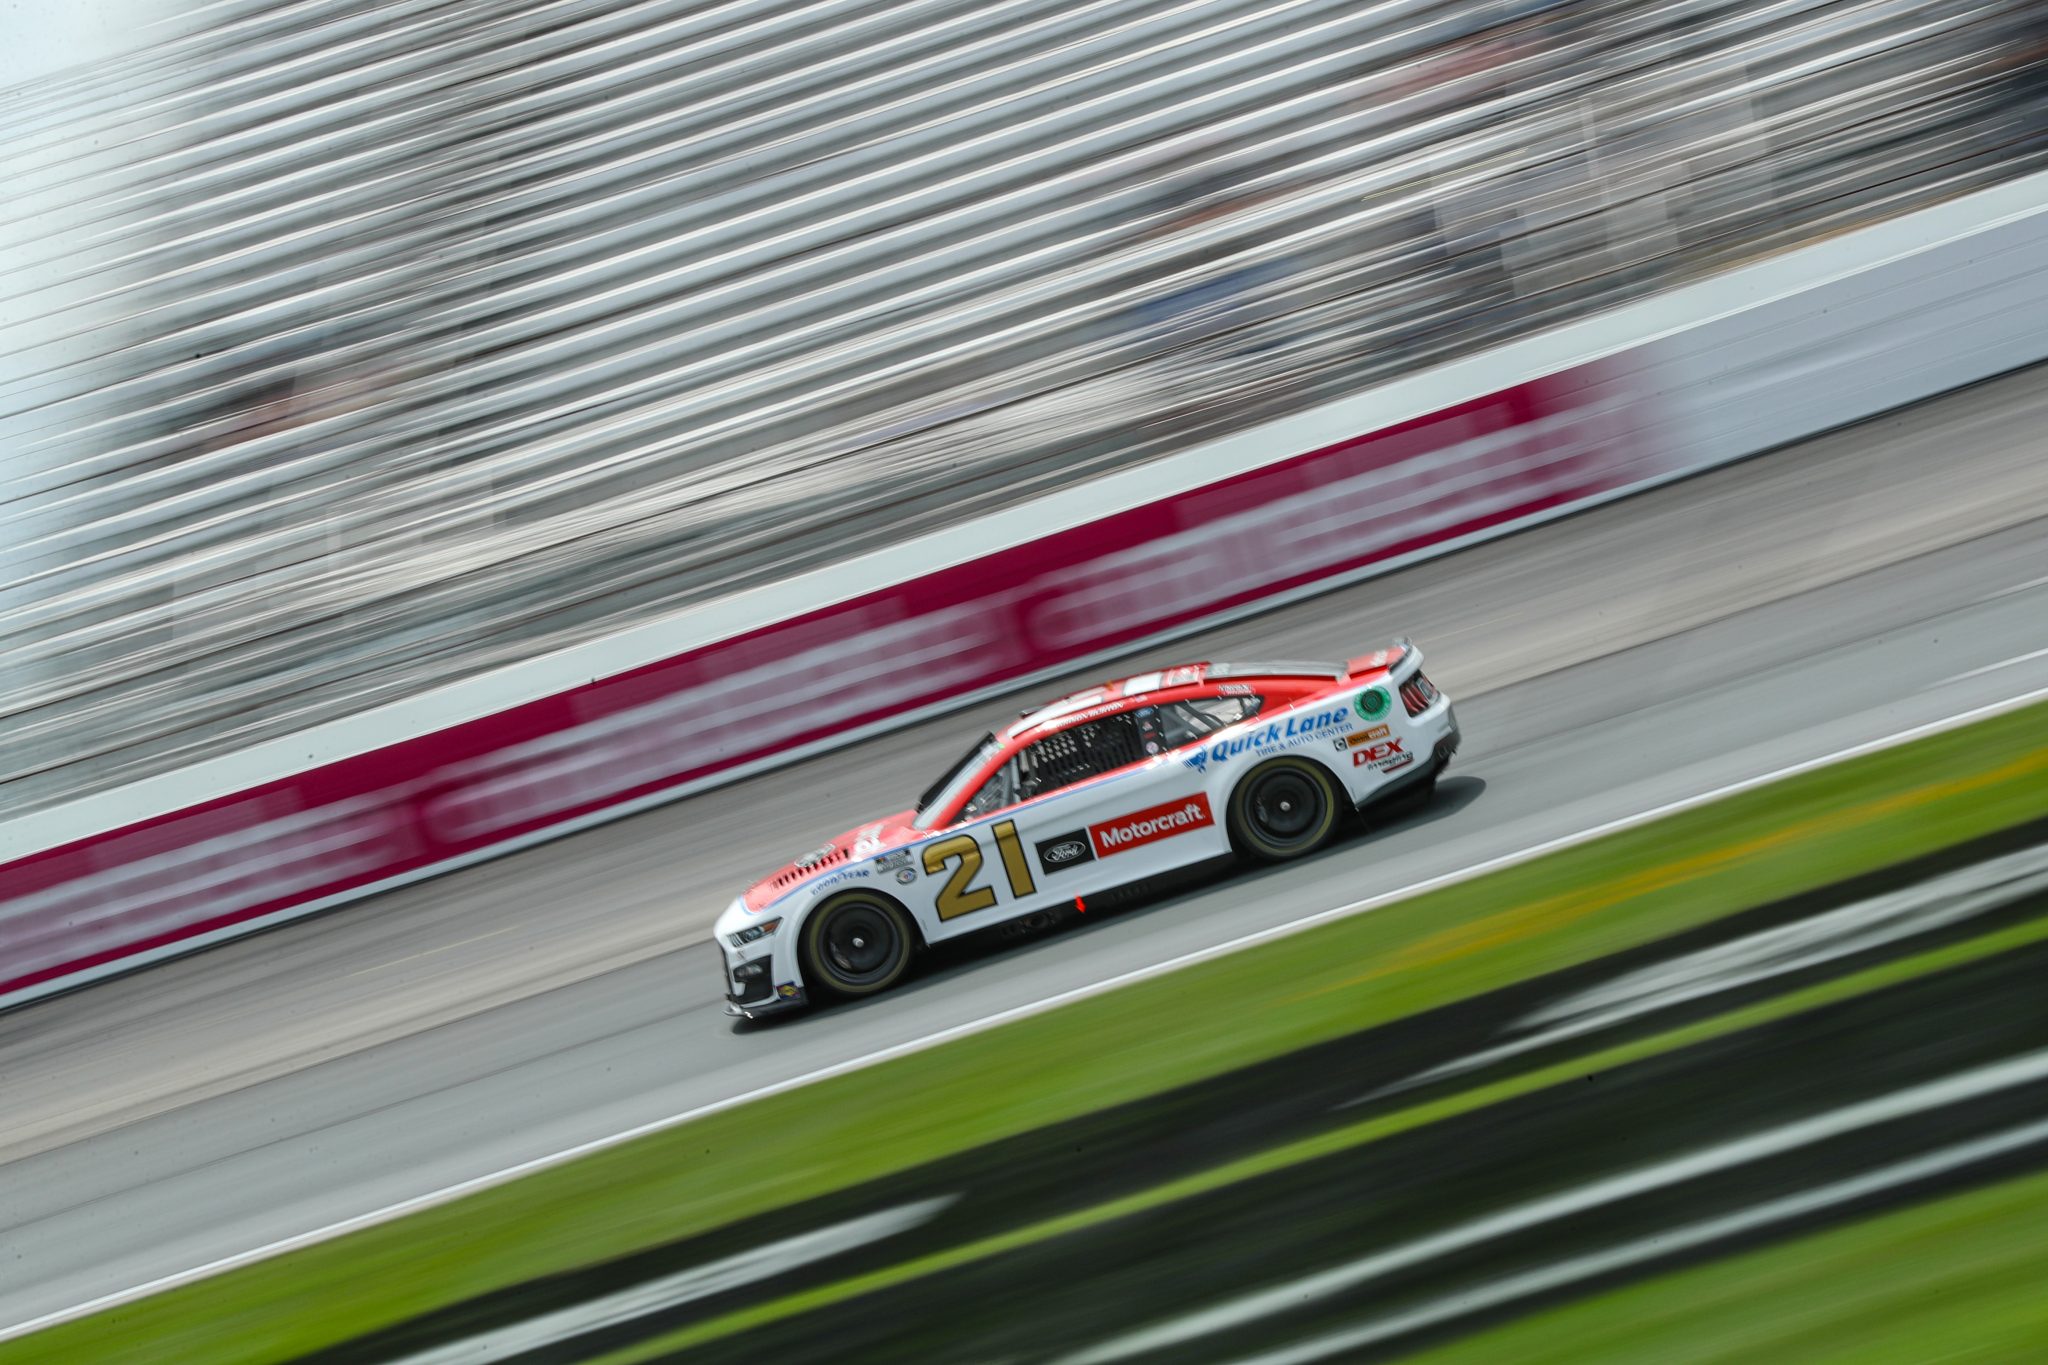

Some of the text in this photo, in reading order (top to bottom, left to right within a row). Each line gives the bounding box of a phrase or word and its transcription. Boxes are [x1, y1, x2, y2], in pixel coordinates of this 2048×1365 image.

[1211, 707, 1349, 762] Quick Lane
[1314, 722, 1354, 740] CENTER
[1353, 737, 1404, 768] DEX
[1100, 803, 1205, 848] Motorcraft
[921, 819, 1037, 923] 21
[1052, 844, 1079, 861] Ford
